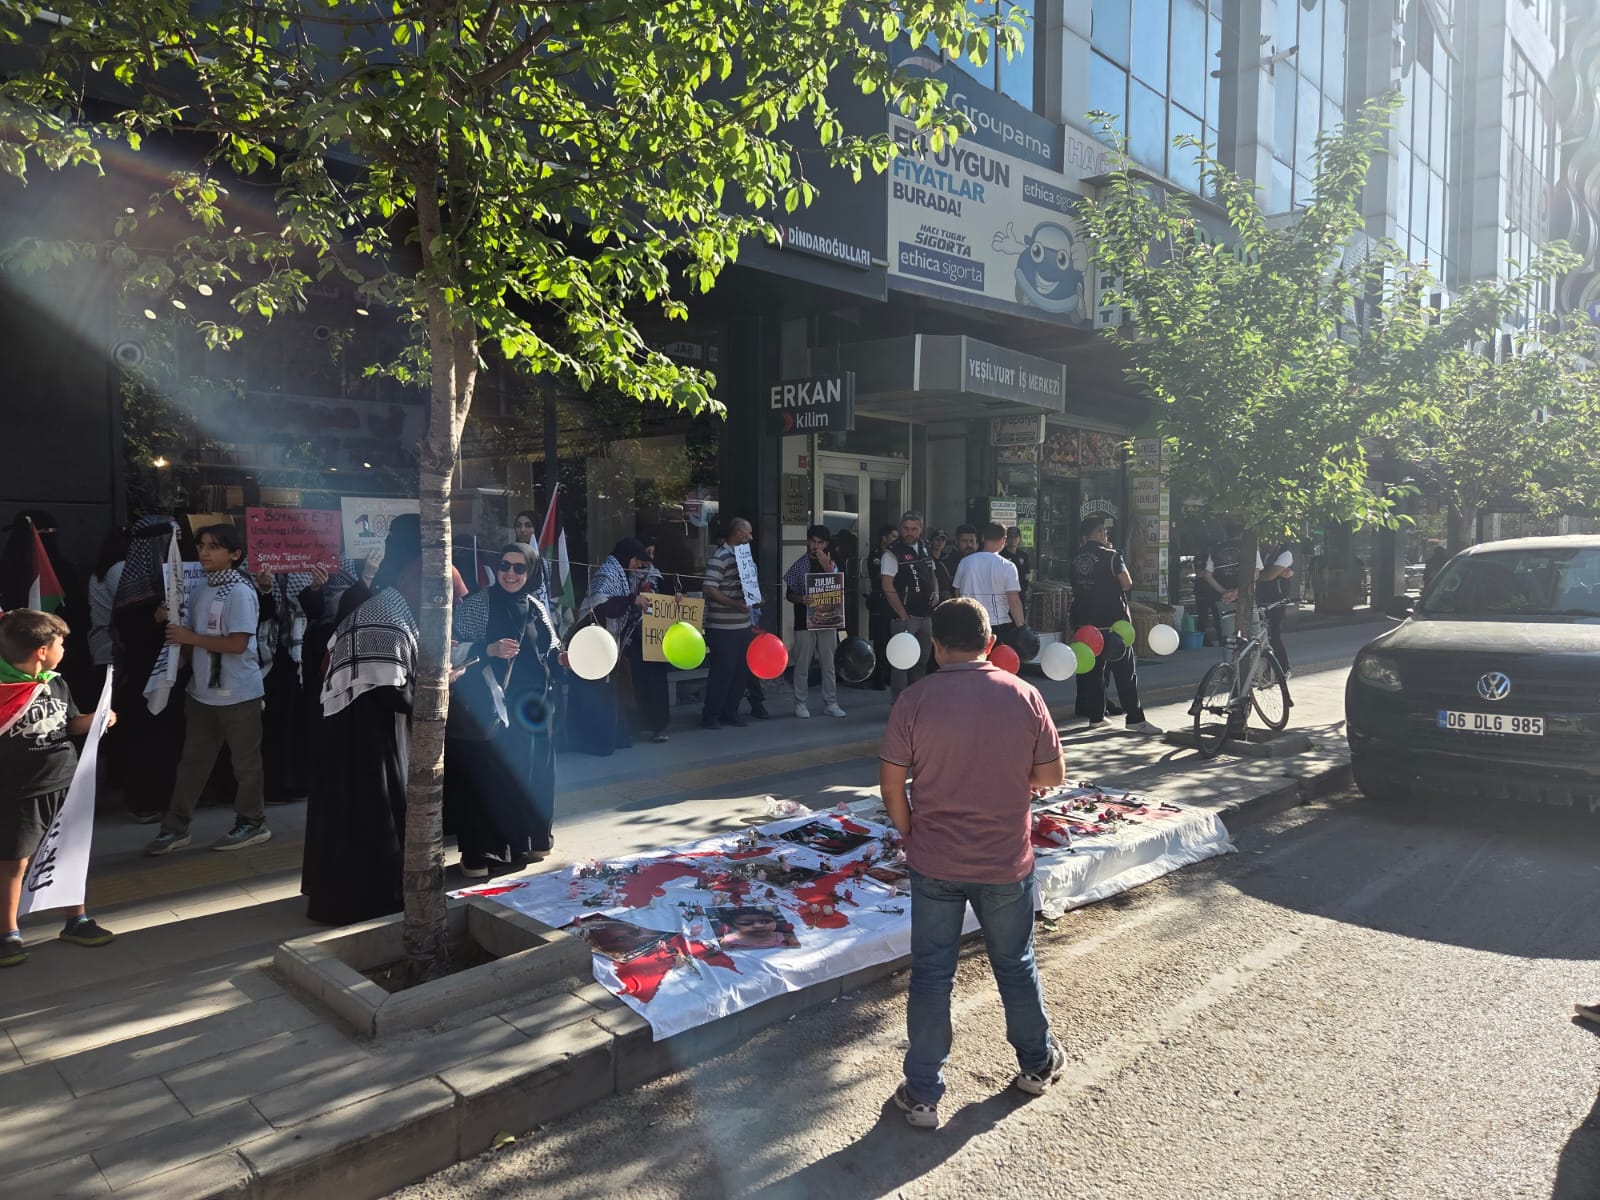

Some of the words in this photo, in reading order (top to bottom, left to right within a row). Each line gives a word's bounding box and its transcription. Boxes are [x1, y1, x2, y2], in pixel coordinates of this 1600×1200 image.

[951, 93, 1051, 159] Groupama
[934, 142, 1010, 188] UYGUN
[893, 181, 962, 217] BURADA!
[1024, 183, 1054, 203] ethica
[788, 226, 870, 266] DİNDAROĞULLARI
[920, 224, 939, 235] HACI
[900, 249, 940, 272] ethica
[942, 260, 982, 282] sigorta
[771, 378, 841, 408] ERKAN
[969, 357, 1015, 386] YEŞİLYURT
[1019, 365, 1027, 392] İŞ
[1028, 373, 1060, 396] MERKEZİ
[796, 411, 829, 429] kilim
[1447, 712, 1466, 728] 06
[1474, 714, 1502, 730] DLG
[1511, 717, 1541, 734] 985
